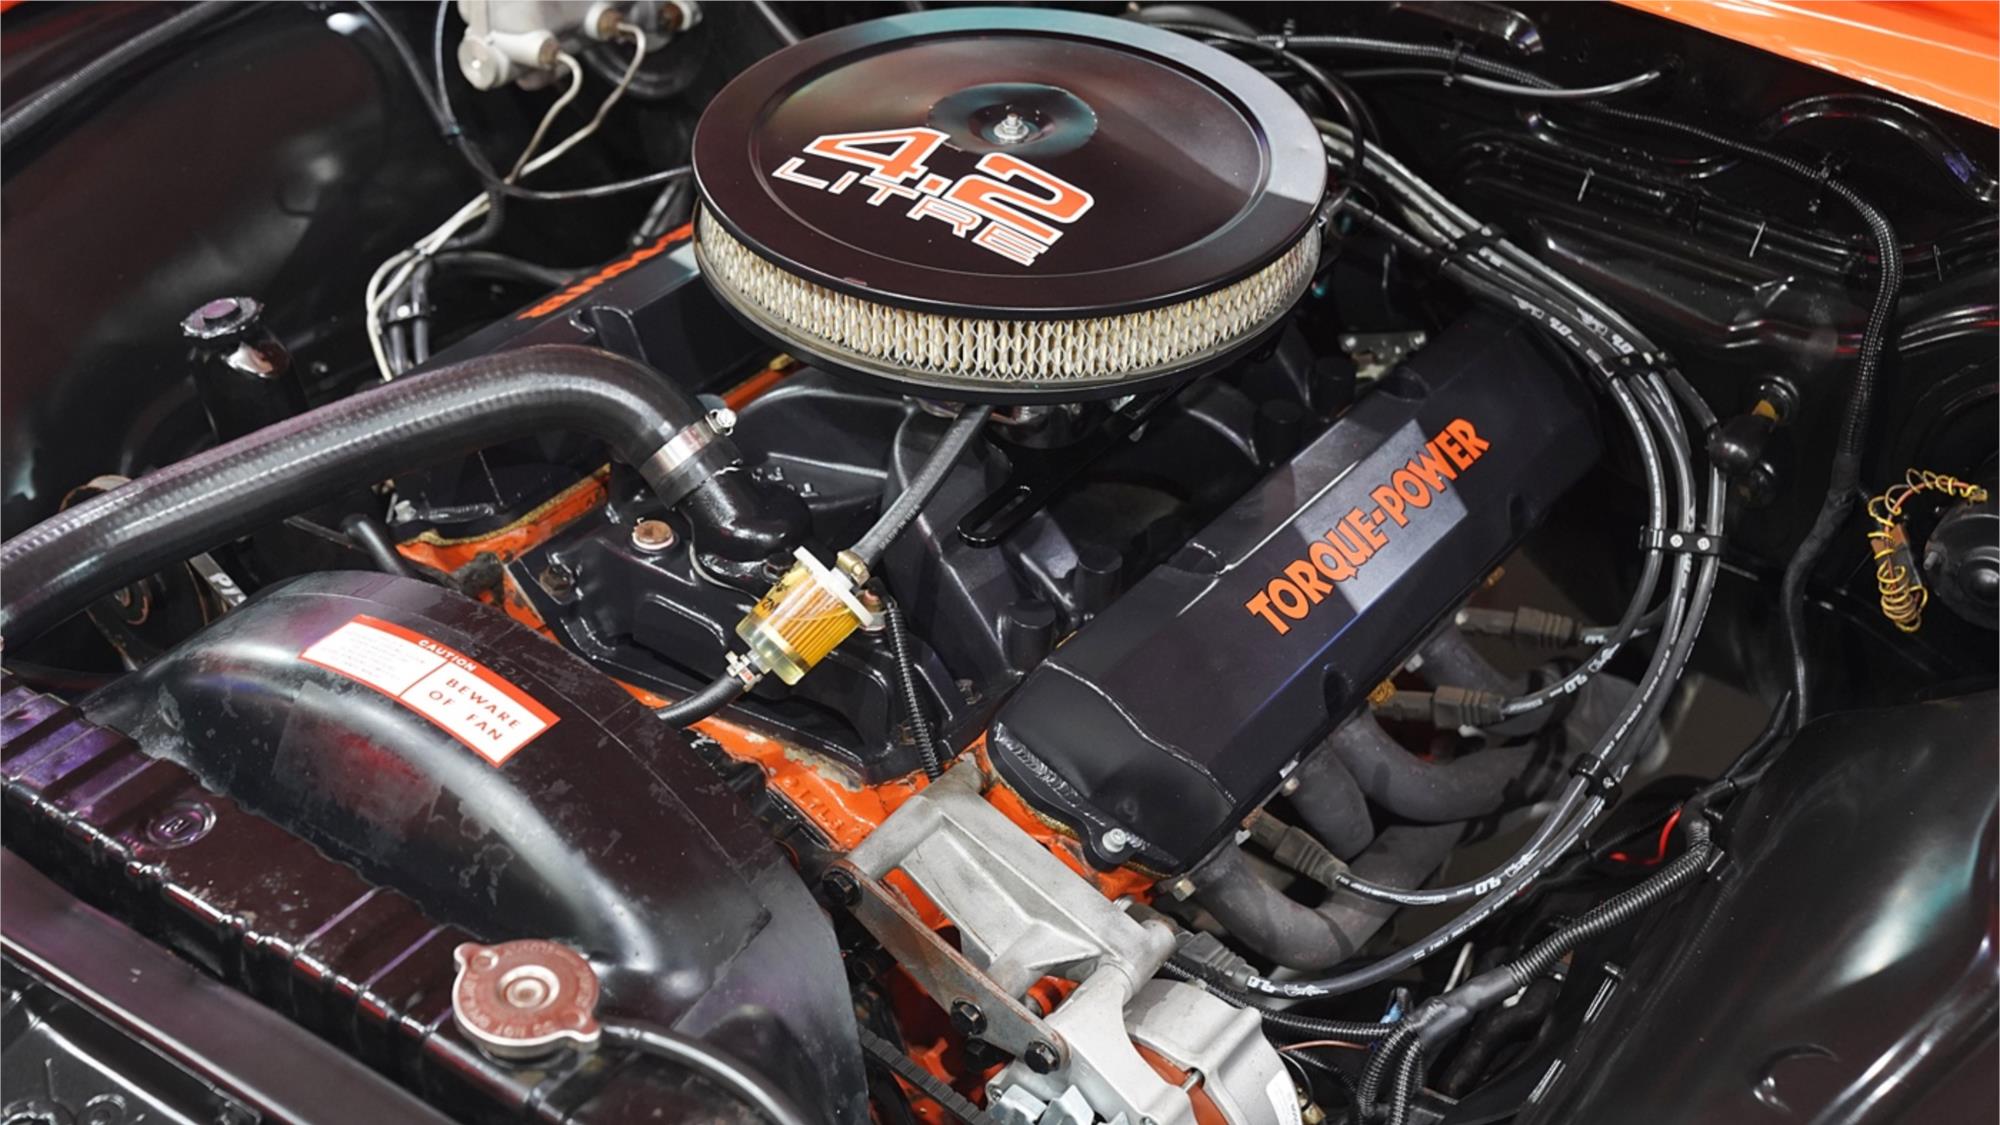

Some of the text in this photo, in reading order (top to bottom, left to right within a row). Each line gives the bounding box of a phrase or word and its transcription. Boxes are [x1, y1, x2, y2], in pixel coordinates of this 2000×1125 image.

[773, 157, 1048, 266] LITRE
[803, 126, 1095, 246] 4.2
[1245, 417, 1491, 636] TORQUE-POWER
[418, 640, 477, 672] CAUTION
[429, 691, 503, 741] OF FAN
[446, 678, 521, 729] BEWARE
